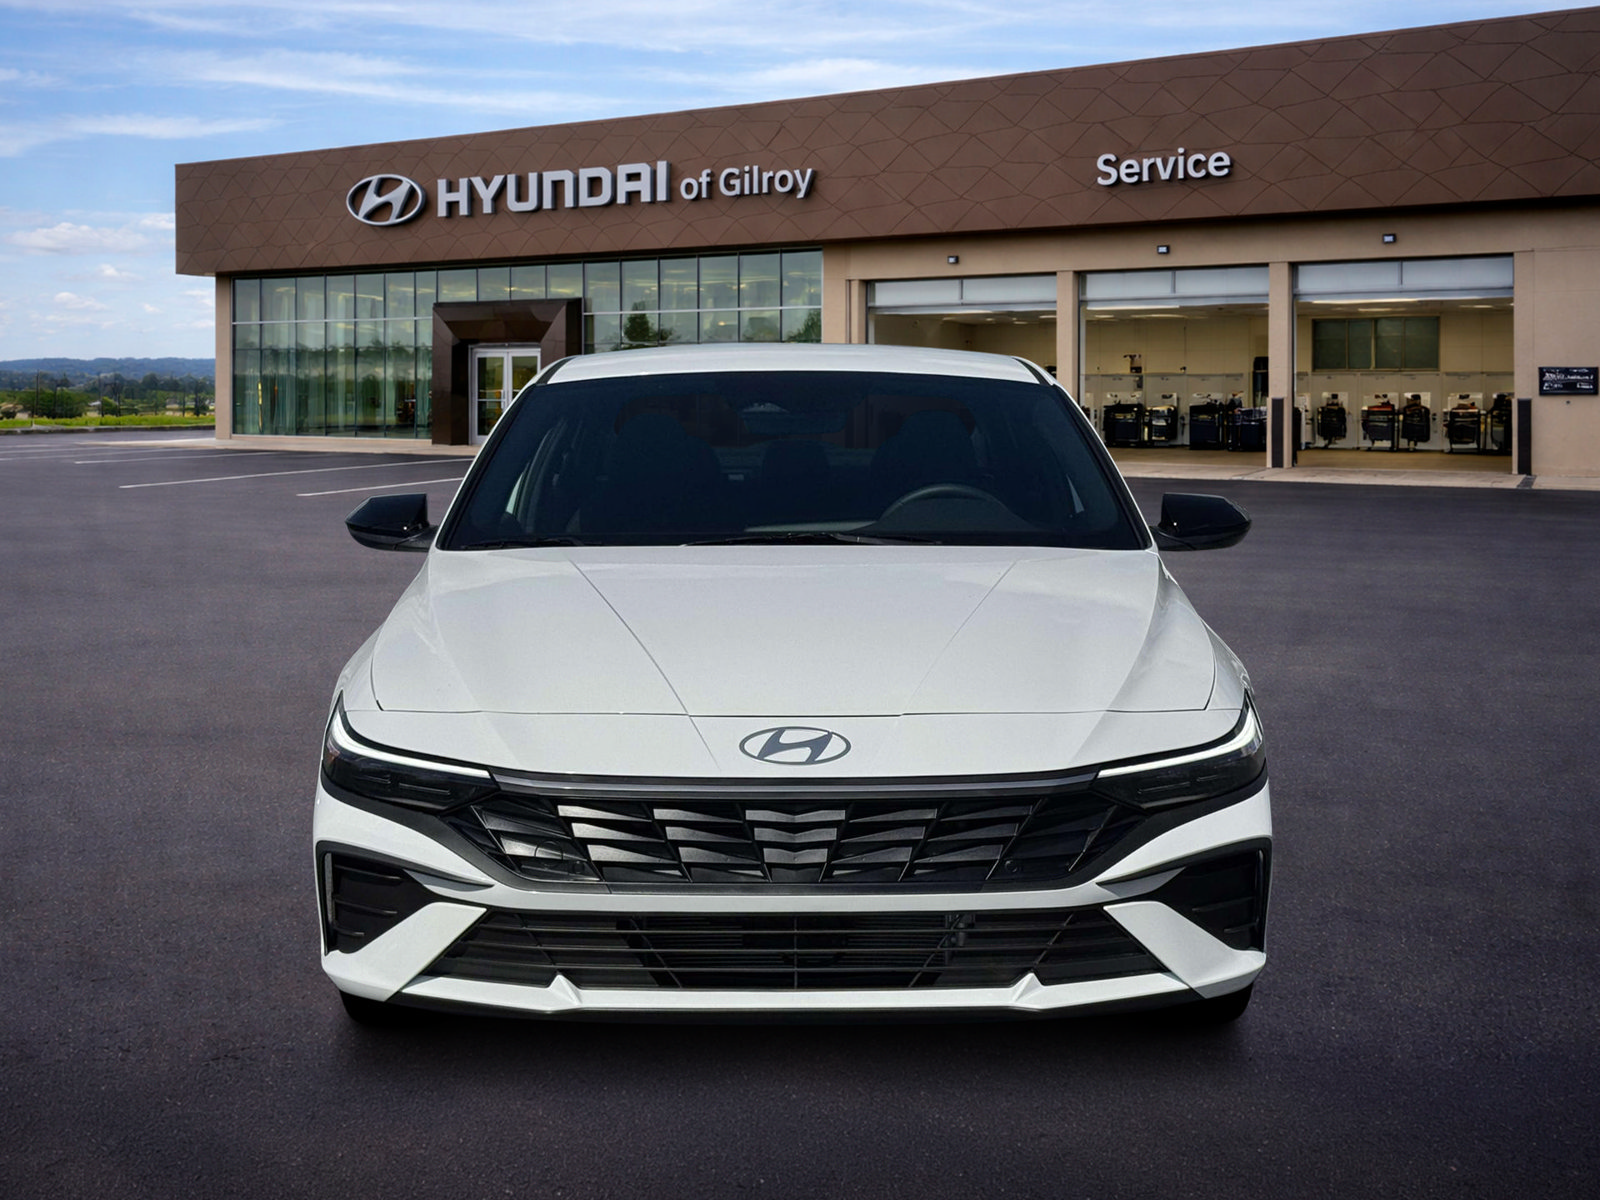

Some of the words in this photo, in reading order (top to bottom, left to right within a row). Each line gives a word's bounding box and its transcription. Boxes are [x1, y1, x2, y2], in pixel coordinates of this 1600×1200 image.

[436, 160, 669, 217] HYUNDAI
[680, 169, 711, 200] of
[718, 165, 813, 198] Gilroy
[1096, 147, 1231, 186] Service
